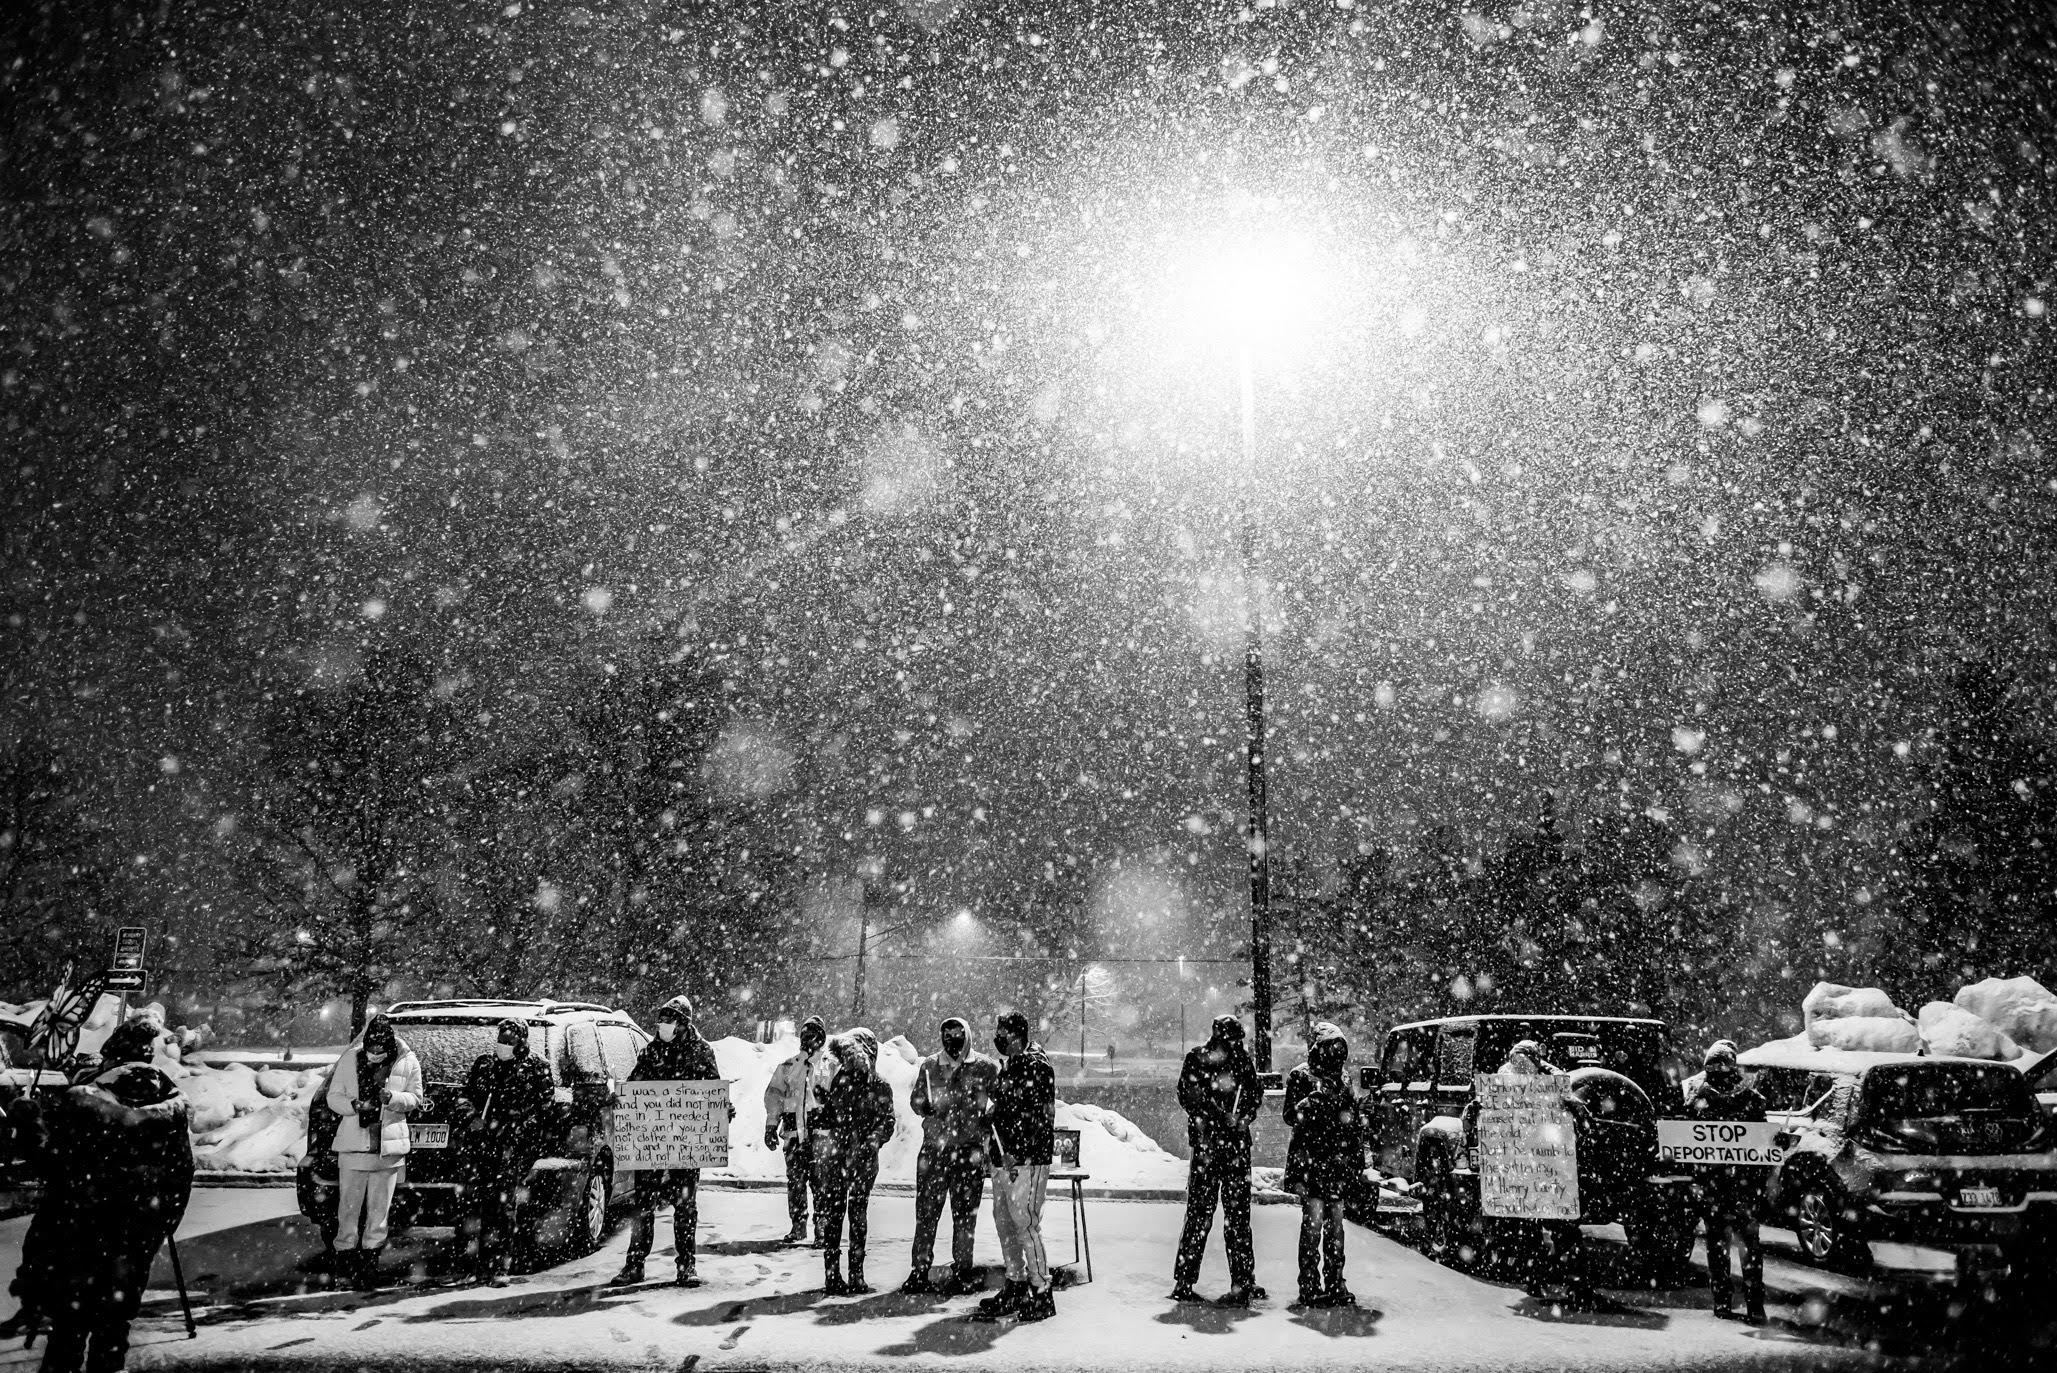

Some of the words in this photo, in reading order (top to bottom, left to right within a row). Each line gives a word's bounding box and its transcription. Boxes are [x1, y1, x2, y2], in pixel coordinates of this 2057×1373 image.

[618, 1082, 627, 1097] I
[632, 1088, 656, 1096] was
[662, 1088, 670, 1096] a
[675, 1082, 726, 1100] stranger
[614, 1097, 638, 1110] and
[644, 1100, 661, 1111] you
[666, 1097, 682, 1108] did
[686, 1100, 704, 1110] not
[655, 1110, 664, 1121] I
[670, 1110, 710, 1122] needed
[615, 1122, 648, 1132] clothes
[652, 1122, 674, 1132] and
[679, 1124, 696, 1137] you
[700, 1121, 720, 1134] did
[1692, 1124, 1747, 1142] STOP
[615, 1132, 632, 1142] not
[637, 1132, 667, 1142] clothe
[696, 1133, 704, 1144] I
[709, 1135, 728, 1144] was
[614, 1140, 640, 1152] sick
[643, 1142, 661, 1152] and
[666, 1142, 676, 1151] in
[680, 1142, 710, 1155] prison
[712, 1144, 728, 1153] and
[1660, 1146, 1783, 1162] DEPORTATIONS
[614, 1153, 630, 1166] you
[635, 1150, 652, 1162] did
[656, 1151, 670, 1162] not
[678, 1152, 697, 1164] look
[700, 1151, 718, 1162] after
[1485, 1176, 1529, 1199] MHenry
